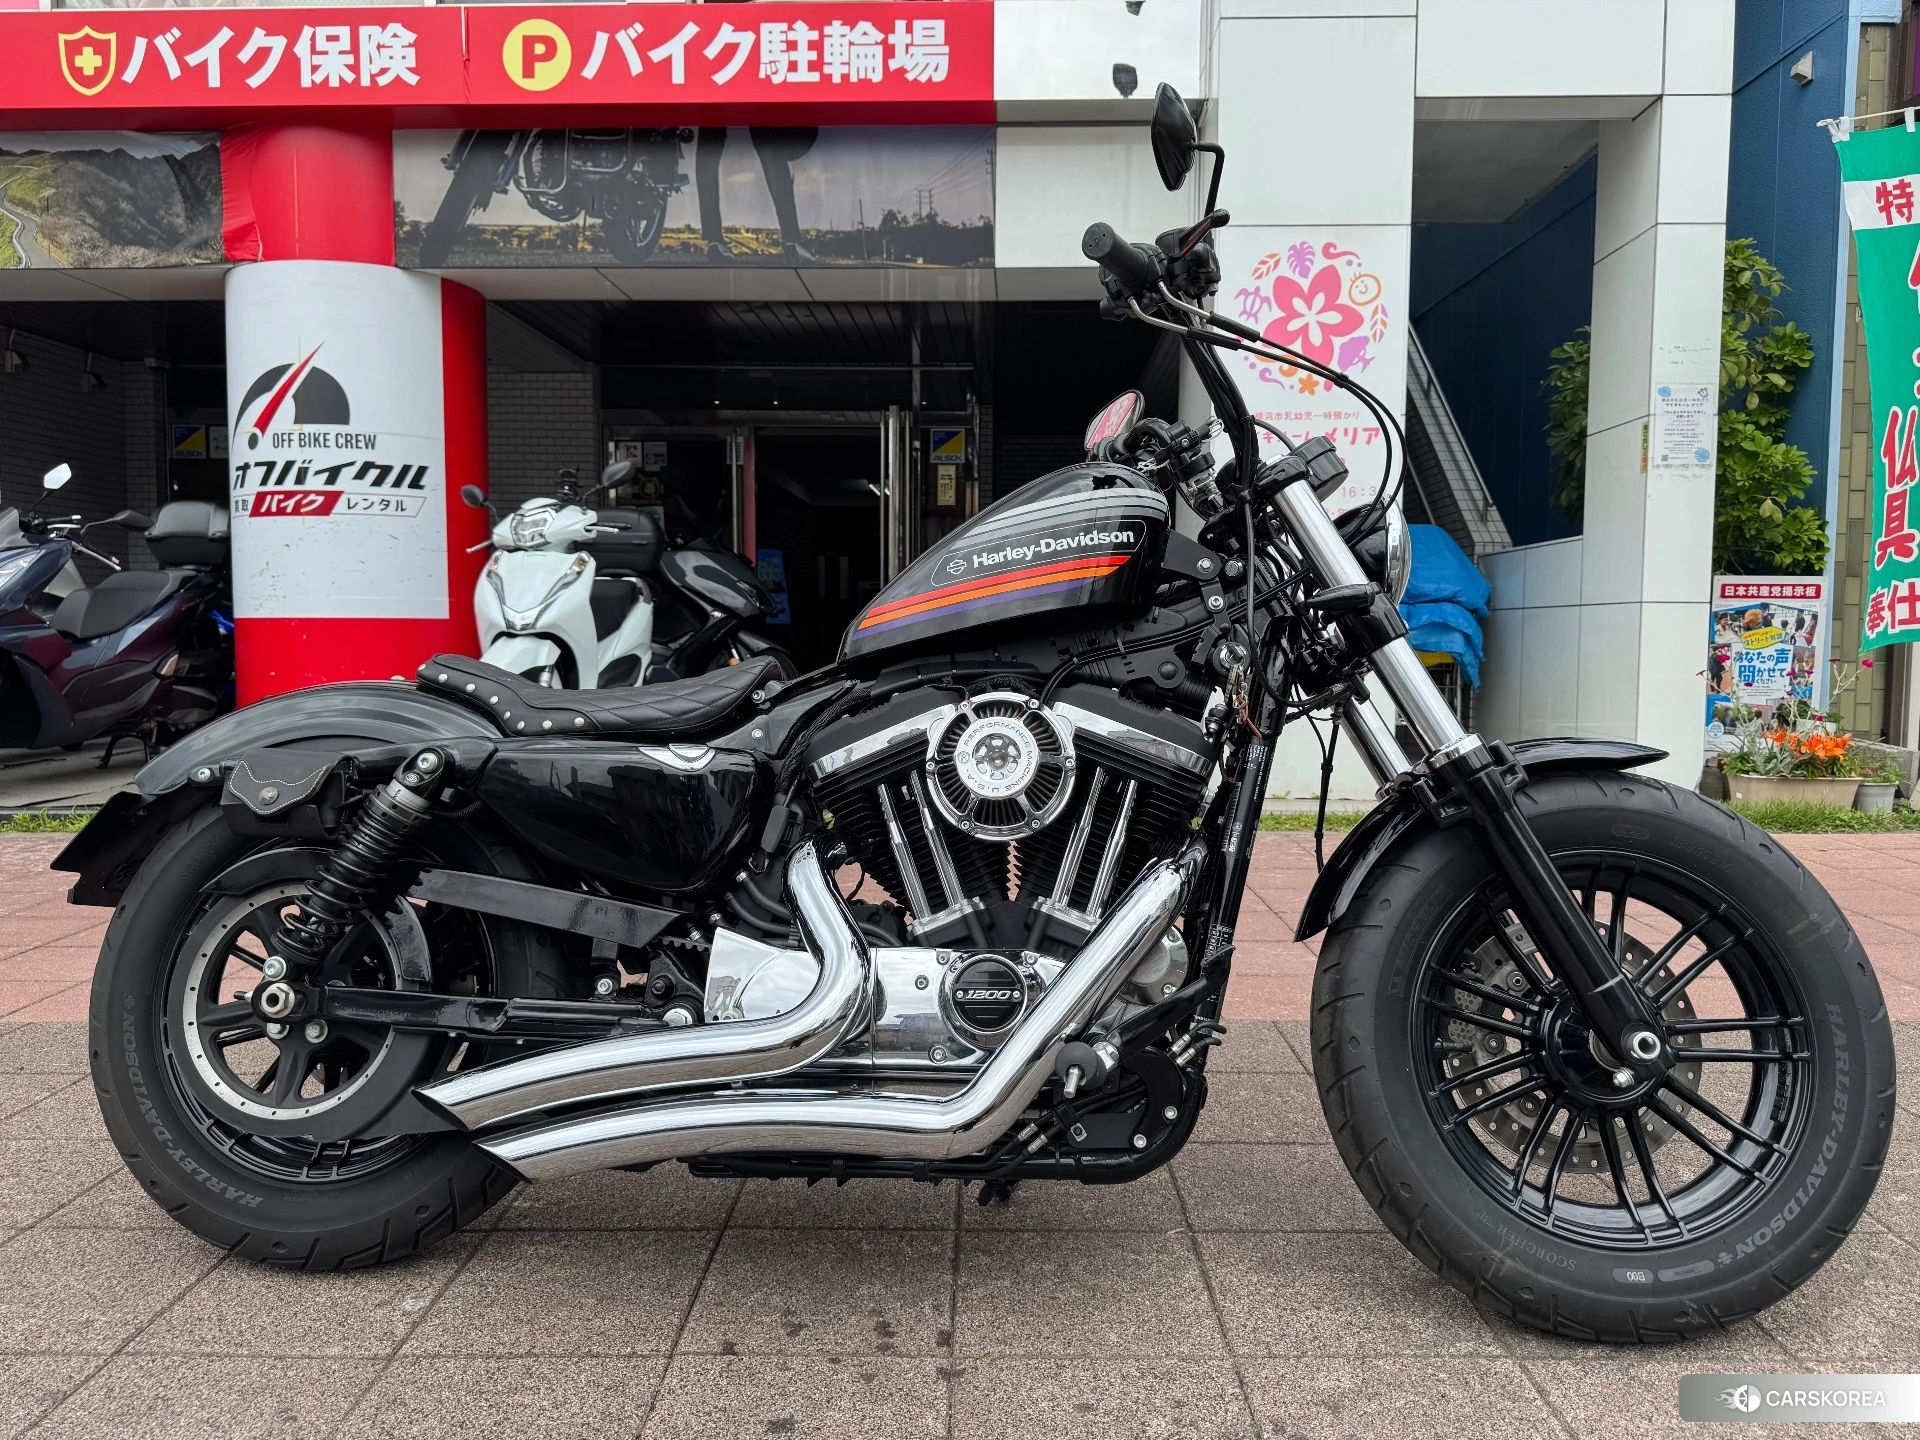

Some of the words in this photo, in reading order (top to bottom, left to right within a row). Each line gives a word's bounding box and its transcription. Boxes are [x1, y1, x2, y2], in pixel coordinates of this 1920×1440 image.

[121, 22, 420, 89] バイク保険
[580, 19, 950, 85] バイク駐輪場
[272, 432, 294, 449] OFF
[299, 432, 331, 449] BIKE
[334, 433, 377, 450] CREW
[233, 459, 430, 491] オフバイクル
[1874, 409, 1918, 568] 仏具
[260, 493, 325, 513] バイク
[346, 497, 407, 512] レンタル
[973, 529, 1135, 569] Harley-Davidson
[1724, 585, 1817, 597] 日本共産党掲示板
[963, 721, 1031, 748] PERFORMANCE
[1004, 749, 1034, 792] MACHINE
[965, 989, 1011, 1000] 1200
[122, 1018, 264, 1208] HARLEY-DAVIDSON
[1736, 1003, 1850, 1260] HARLEY-DAVIDSON
[1496, 1224, 1576, 1271] SCORCHER
